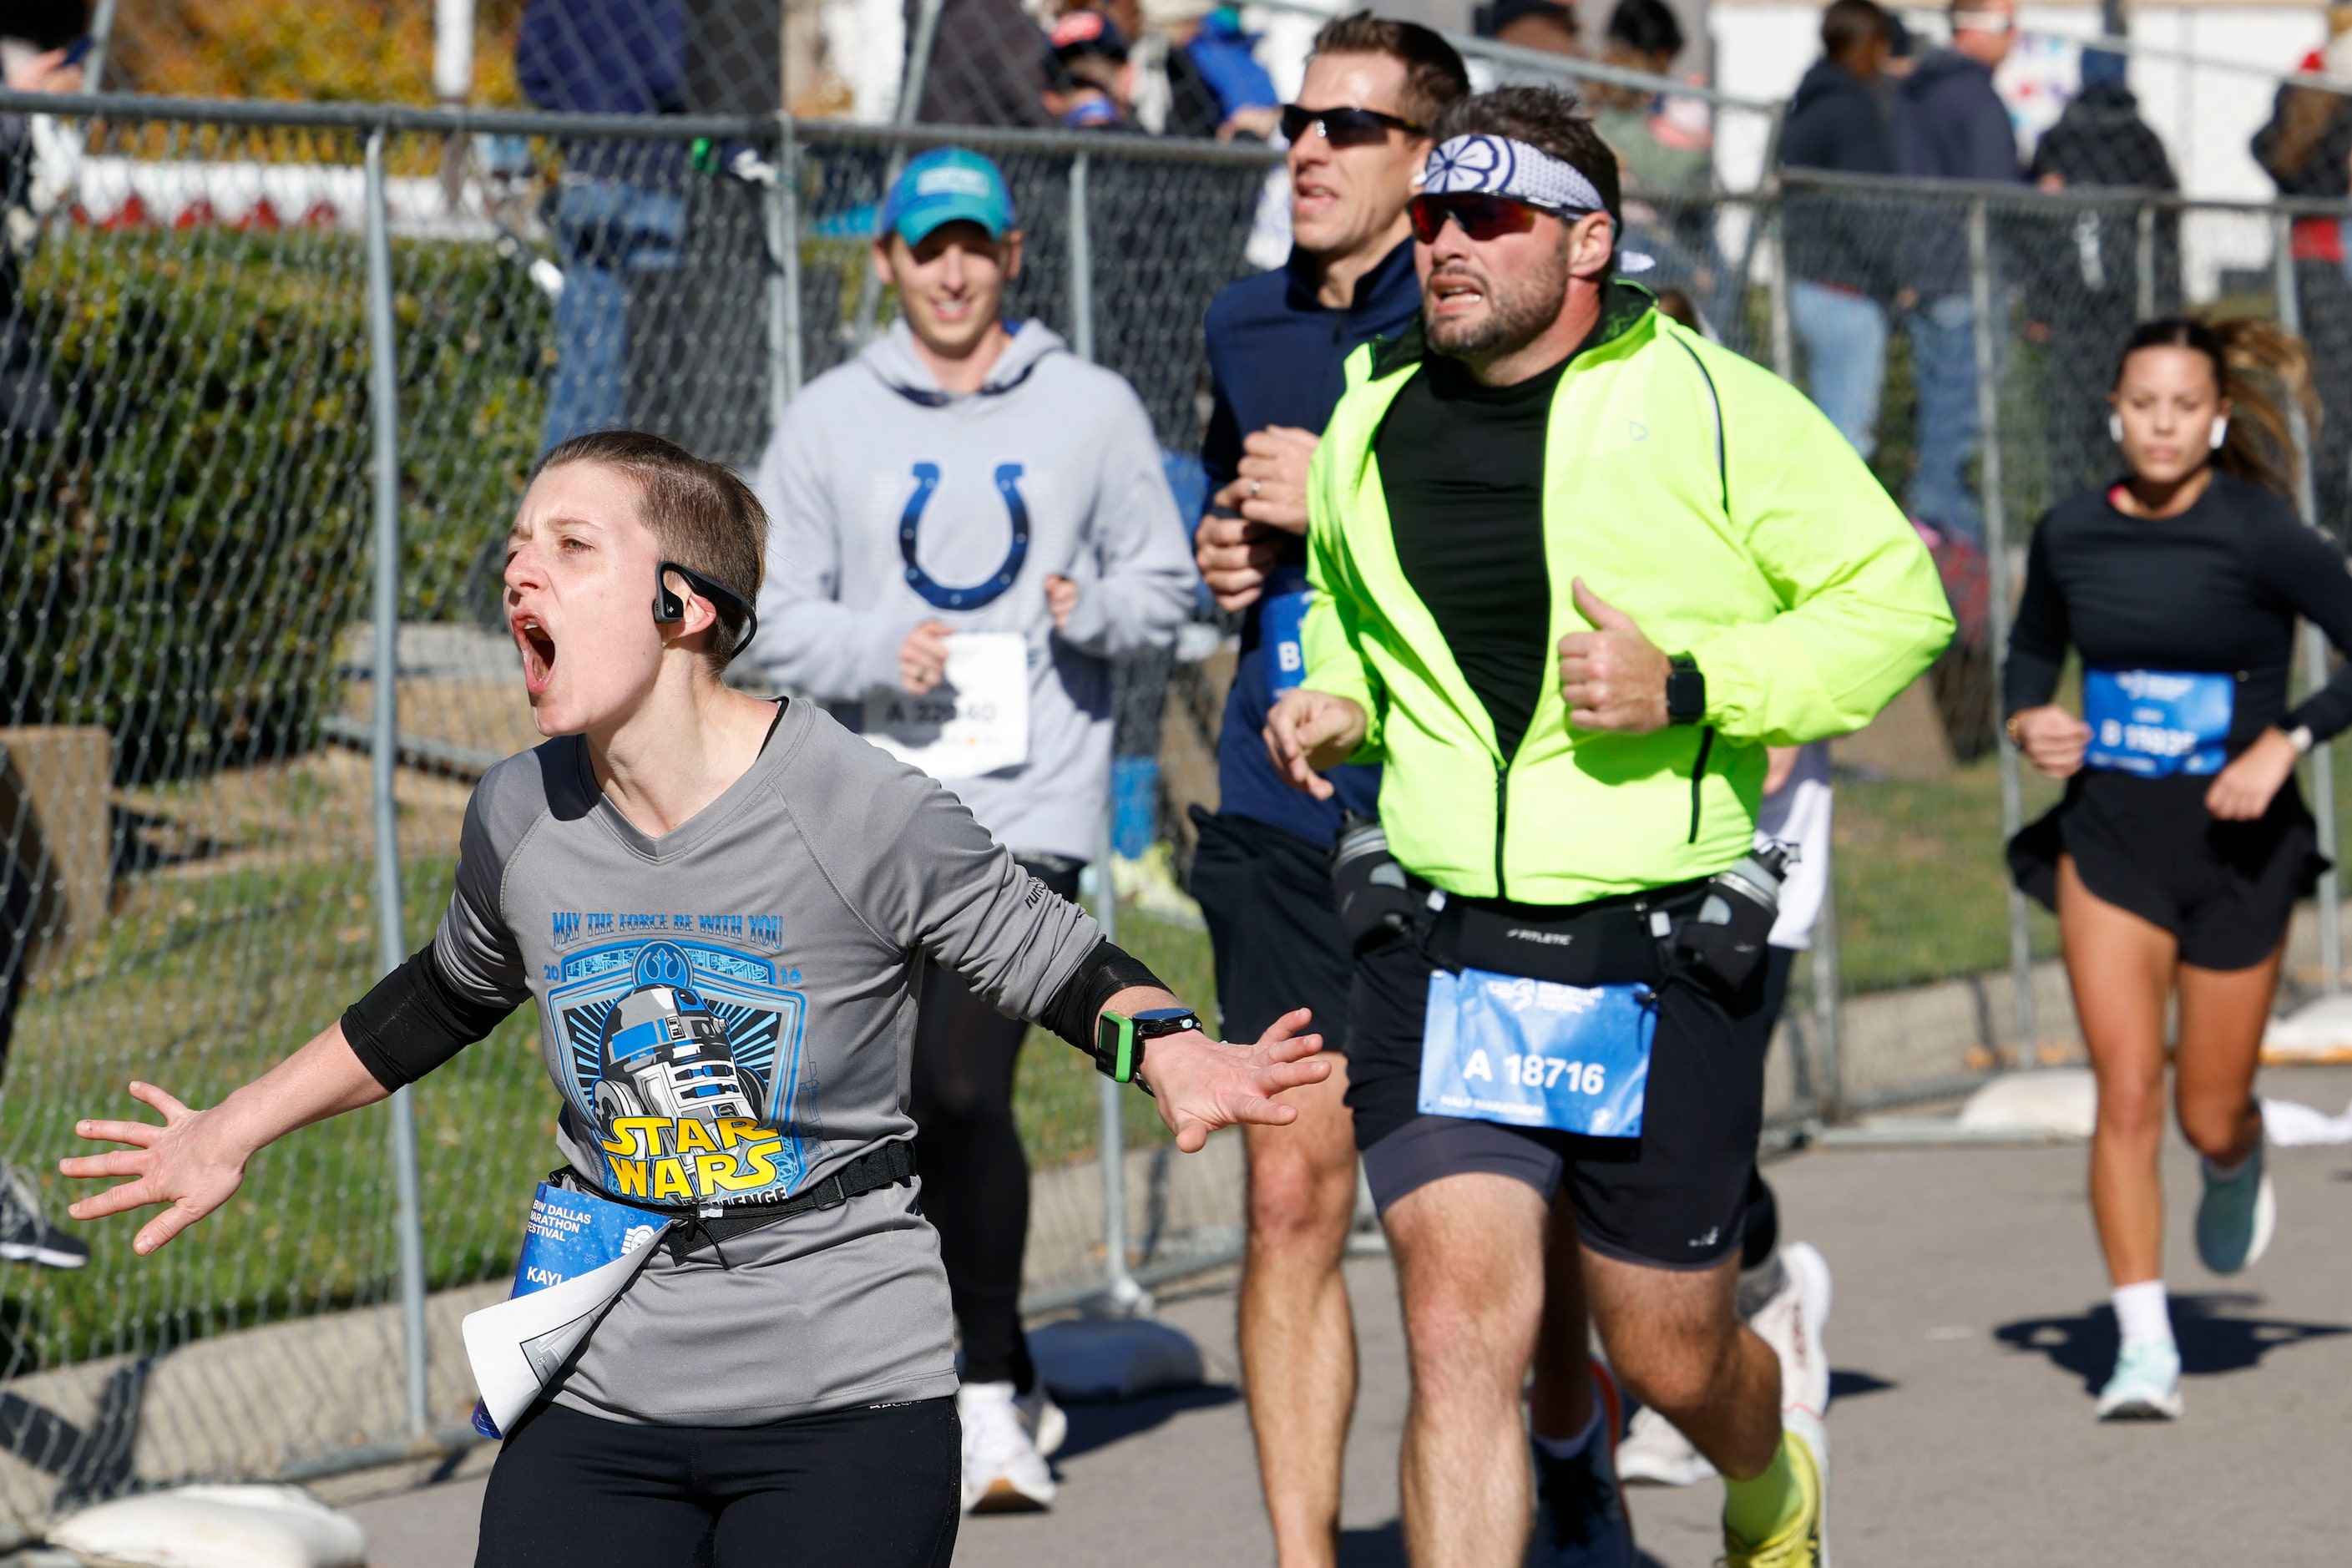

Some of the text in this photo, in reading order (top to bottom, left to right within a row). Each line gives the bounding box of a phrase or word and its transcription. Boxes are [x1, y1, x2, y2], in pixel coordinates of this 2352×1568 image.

[1278, 641, 1301, 671] B
[553, 913, 783, 950] MAY THE FORCE BE WITH YOU
[544, 964, 802, 984] 20 16
[1463, 1050, 1606, 1095] A 18716
[600, 1116, 780, 1156] STAR
[608, 1141, 784, 1200] WARS
[529, 1210, 580, 1233] MARATHON
[547, 1204, 592, 1225] DALLAS
[528, 1222, 566, 1242] FESTIVAL
